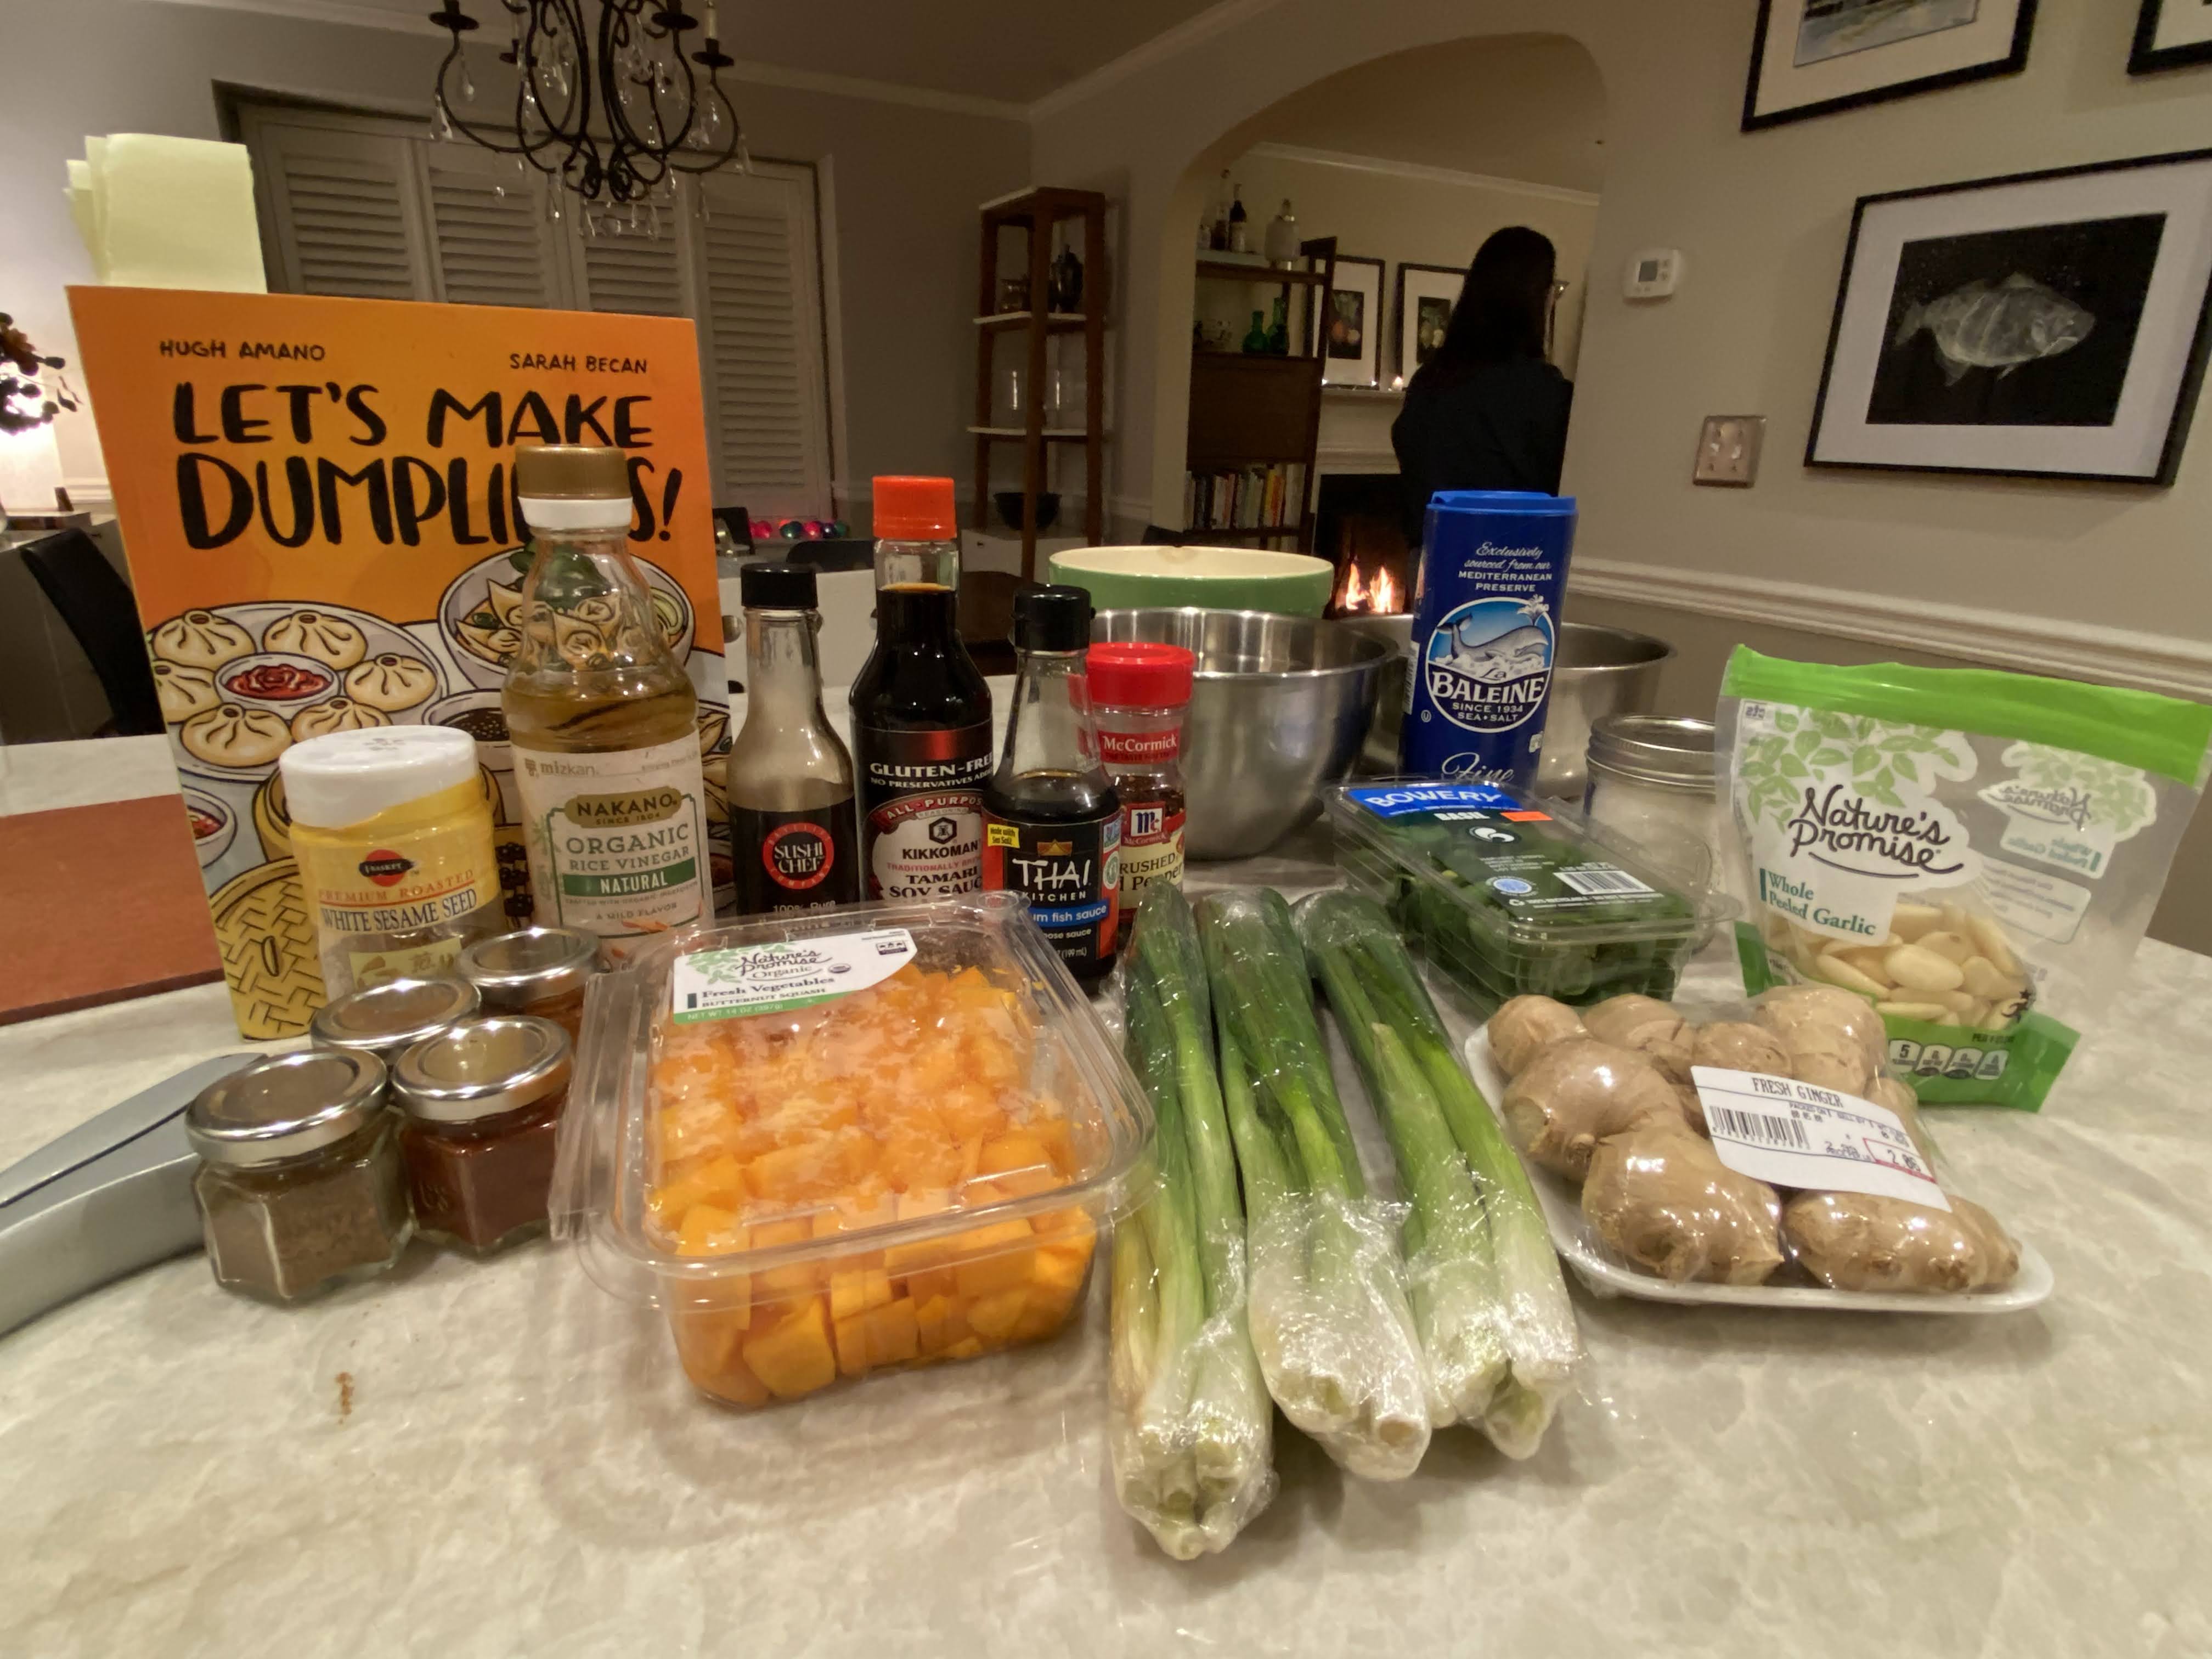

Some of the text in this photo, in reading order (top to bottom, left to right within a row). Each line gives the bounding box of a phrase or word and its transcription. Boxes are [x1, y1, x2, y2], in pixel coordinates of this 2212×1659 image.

[160, 340, 325, 362] HUGH AMANO
[510, 354, 647, 374] SARAH BECAN
[173, 381, 652, 448] LET'S MAKE
[176, 452, 682, 549] DUMPLIS!
[1476, 541, 1543, 560] Exclusively
[1464, 560, 1507, 569] sourced
[1503, 559, 1534, 572] from
[1458, 571, 1552, 582] MEDITERRANEAN
[1475, 583, 1536, 592] PRESERVE
[1480, 668, 1506, 681] La
[1432, 671, 1545, 704] BALEINE
[1452, 702, 1523, 713] SINCE 1934
[1457, 712, 1518, 722] SEA SALT
[1103, 733, 1177, 752] McCormick
[1442, 752, 1514, 783] Fine
[870, 777, 886, 786] NO
[888, 775, 973, 788] PRESERVATIVES
[577, 793, 674, 817] NAKANO
[1363, 789, 1502, 807] BOWERY
[596, 816, 629, 825] SINCE
[1433, 811, 1491, 821] BASIL
[1800, 785, 1951, 845] Nature's
[566, 823, 689, 855] ORGANIC
[1787, 818, 1965, 874] Promise
[569, 847, 690, 871] RICE VINEGAR
[774, 842, 823, 860] SUSHI
[902, 840, 979, 860] KIKKOMAN
[778, 855, 825, 874] CHEF
[886, 860, 959, 872] TRADITIONALLY
[1119, 852, 1176, 874] RUSHED
[600, 871, 668, 894] NATURAL
[906, 866, 978, 884] TAMARI
[1012, 858, 1091, 891] THAI
[319, 868, 474, 901] PREMIUM ROASTED
[889, 876, 982, 899] SOY SAUC
[1768, 871, 1814, 901] Whole
[1023, 891, 1086, 902] KITCHEN
[320, 888, 477, 932] WHITE SESAME SEED
[607, 910, 634, 920] MILD
[637, 901, 677, 917] FLAVOR
[1052, 911, 1073, 922] fish
[1075, 905, 1107, 921] sauce
[1769, 890, 1877, 936] Peeled Garlic
[1066, 928, 1092, 939] sauce
[735, 957, 833, 976] Promise
[741, 949, 822, 965] Nature's
[752, 966, 812, 978] Organic
[702, 977, 835, 998] Fresh Vegetables
[702, 988, 826, 1007] BUTTERNUT SQUASH
[687, 1012, 705, 1020] NET
[1899, 1043, 1911, 1059] 5
[1751, 1077, 1844, 1108] FRESH GINGER
